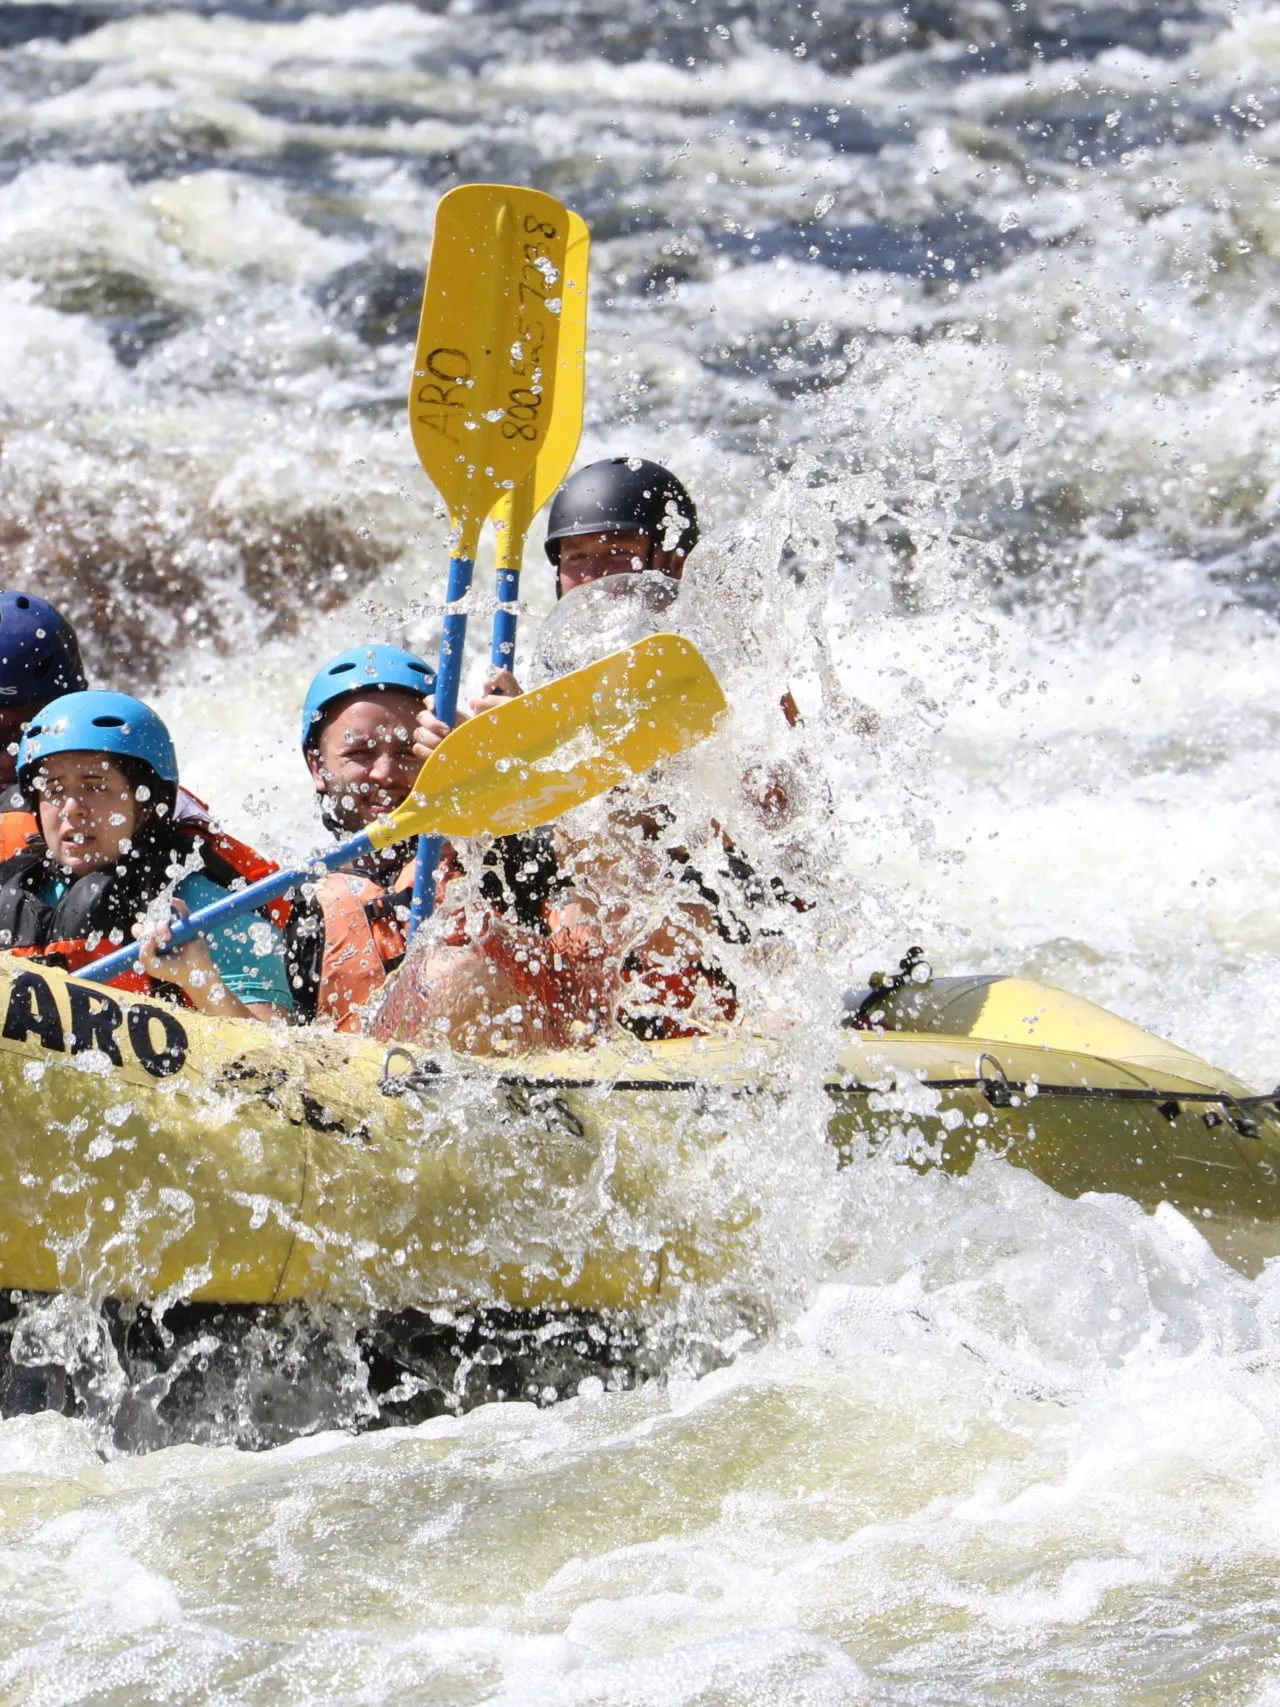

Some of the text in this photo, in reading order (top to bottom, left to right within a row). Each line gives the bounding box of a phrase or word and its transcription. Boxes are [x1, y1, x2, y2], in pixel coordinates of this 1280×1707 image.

[417, 347, 472, 445] ARO
[501, 388, 542, 441] 800
[2, 971, 189, 1079] ARO
